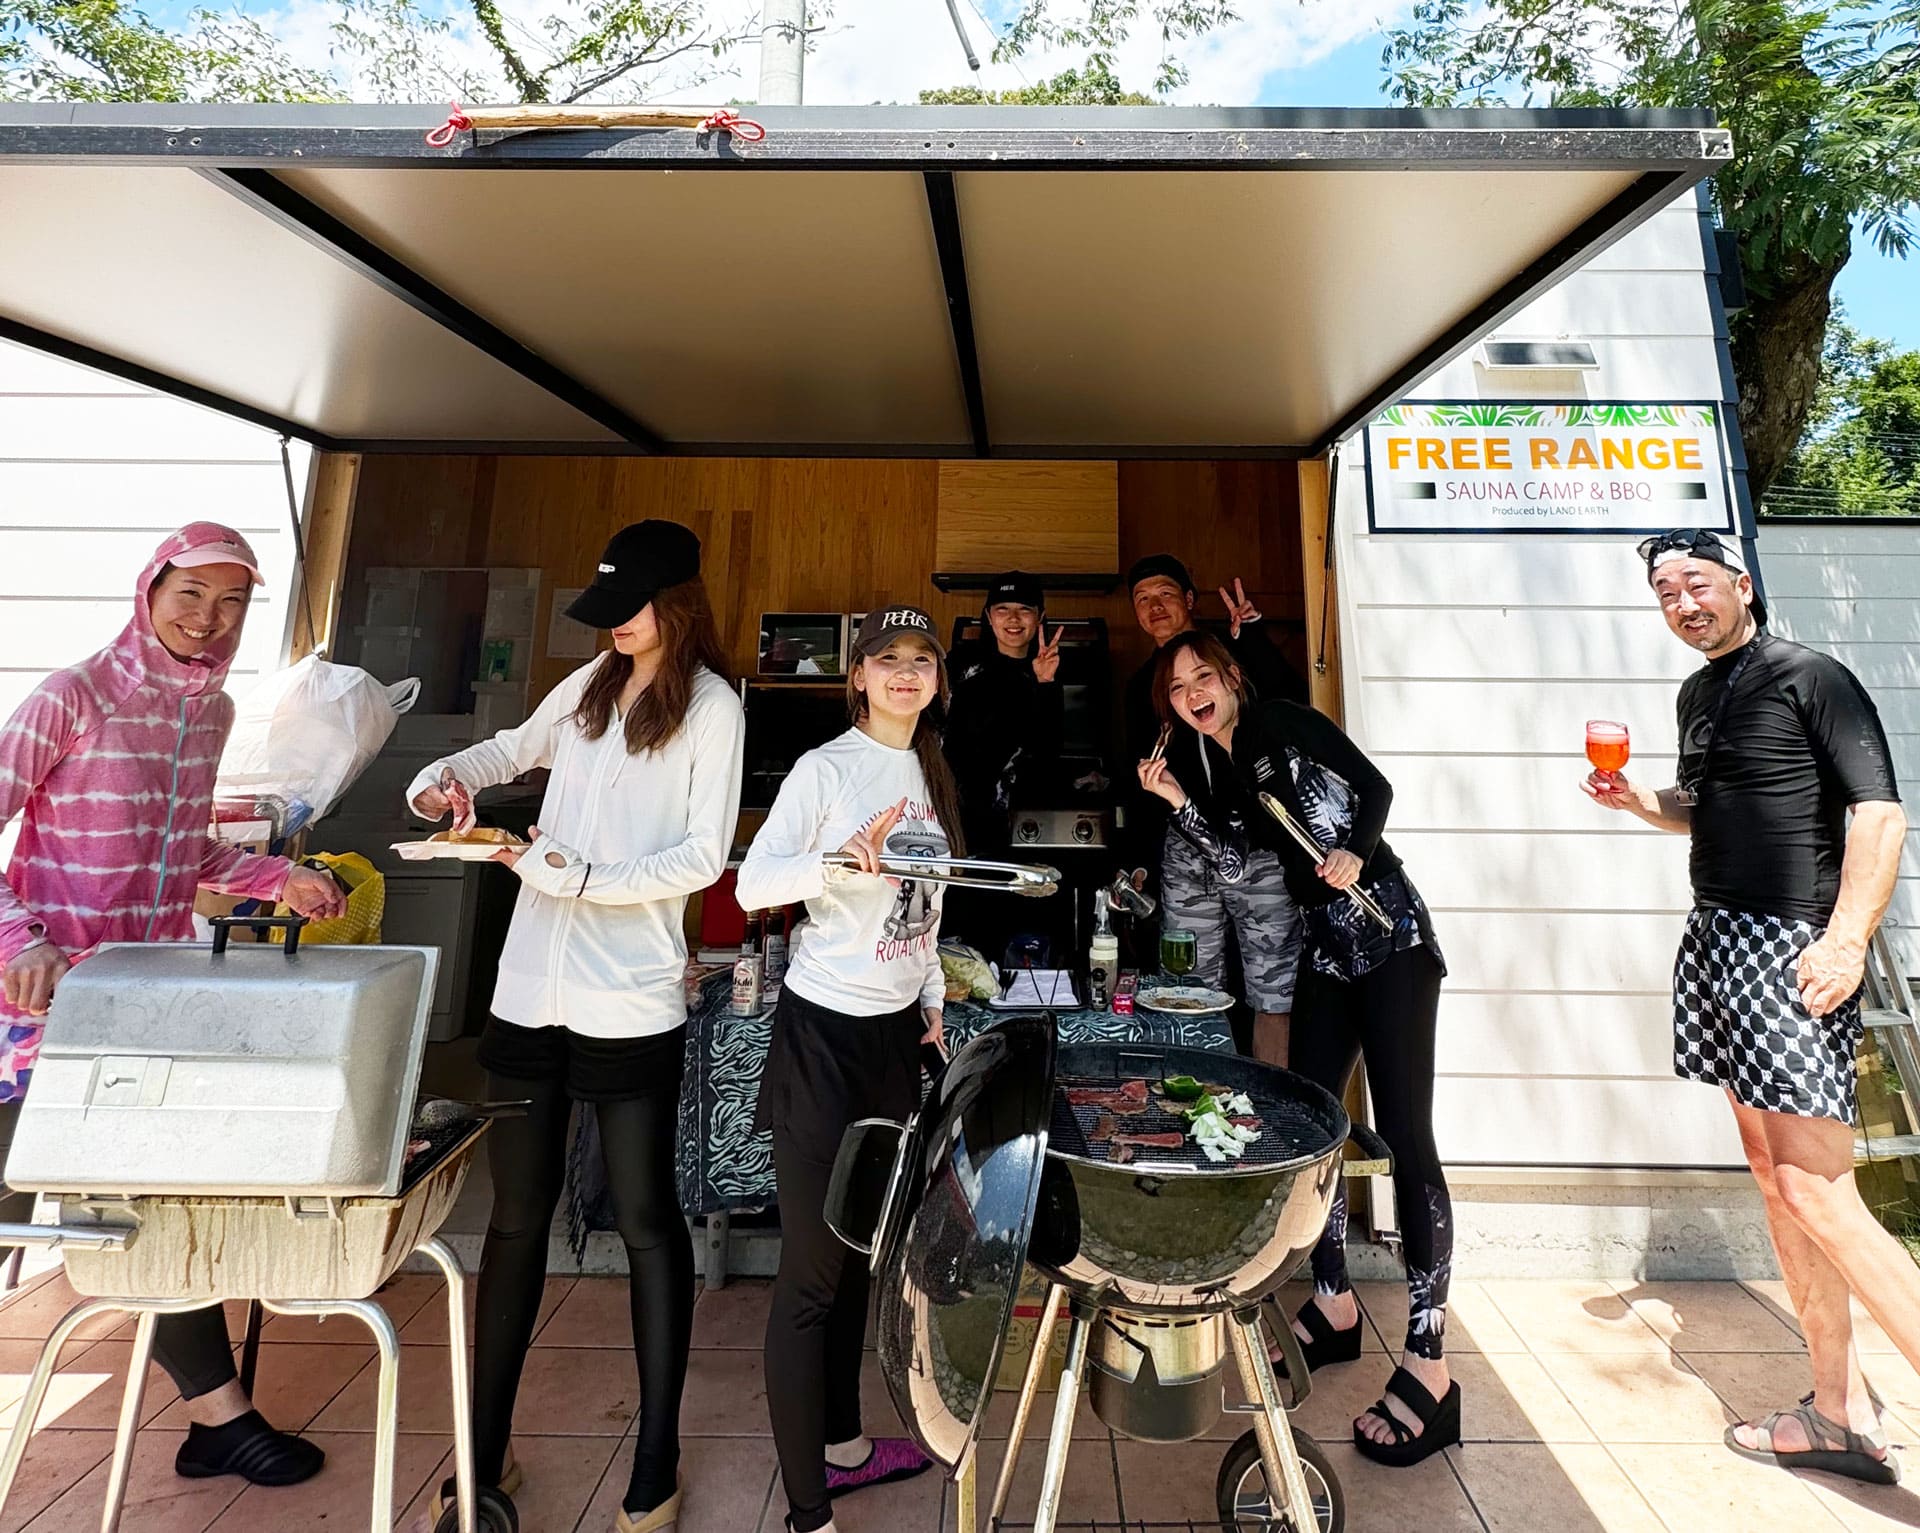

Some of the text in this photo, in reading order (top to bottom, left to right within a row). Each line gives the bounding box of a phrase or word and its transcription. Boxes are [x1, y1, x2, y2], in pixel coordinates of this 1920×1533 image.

[1386, 437, 1704, 470] FREE RANGE
[1445, 482, 1652, 502] SAUNA CAMP & BBQ
[1492, 505, 1609, 517] Produced by LAND EARTH
